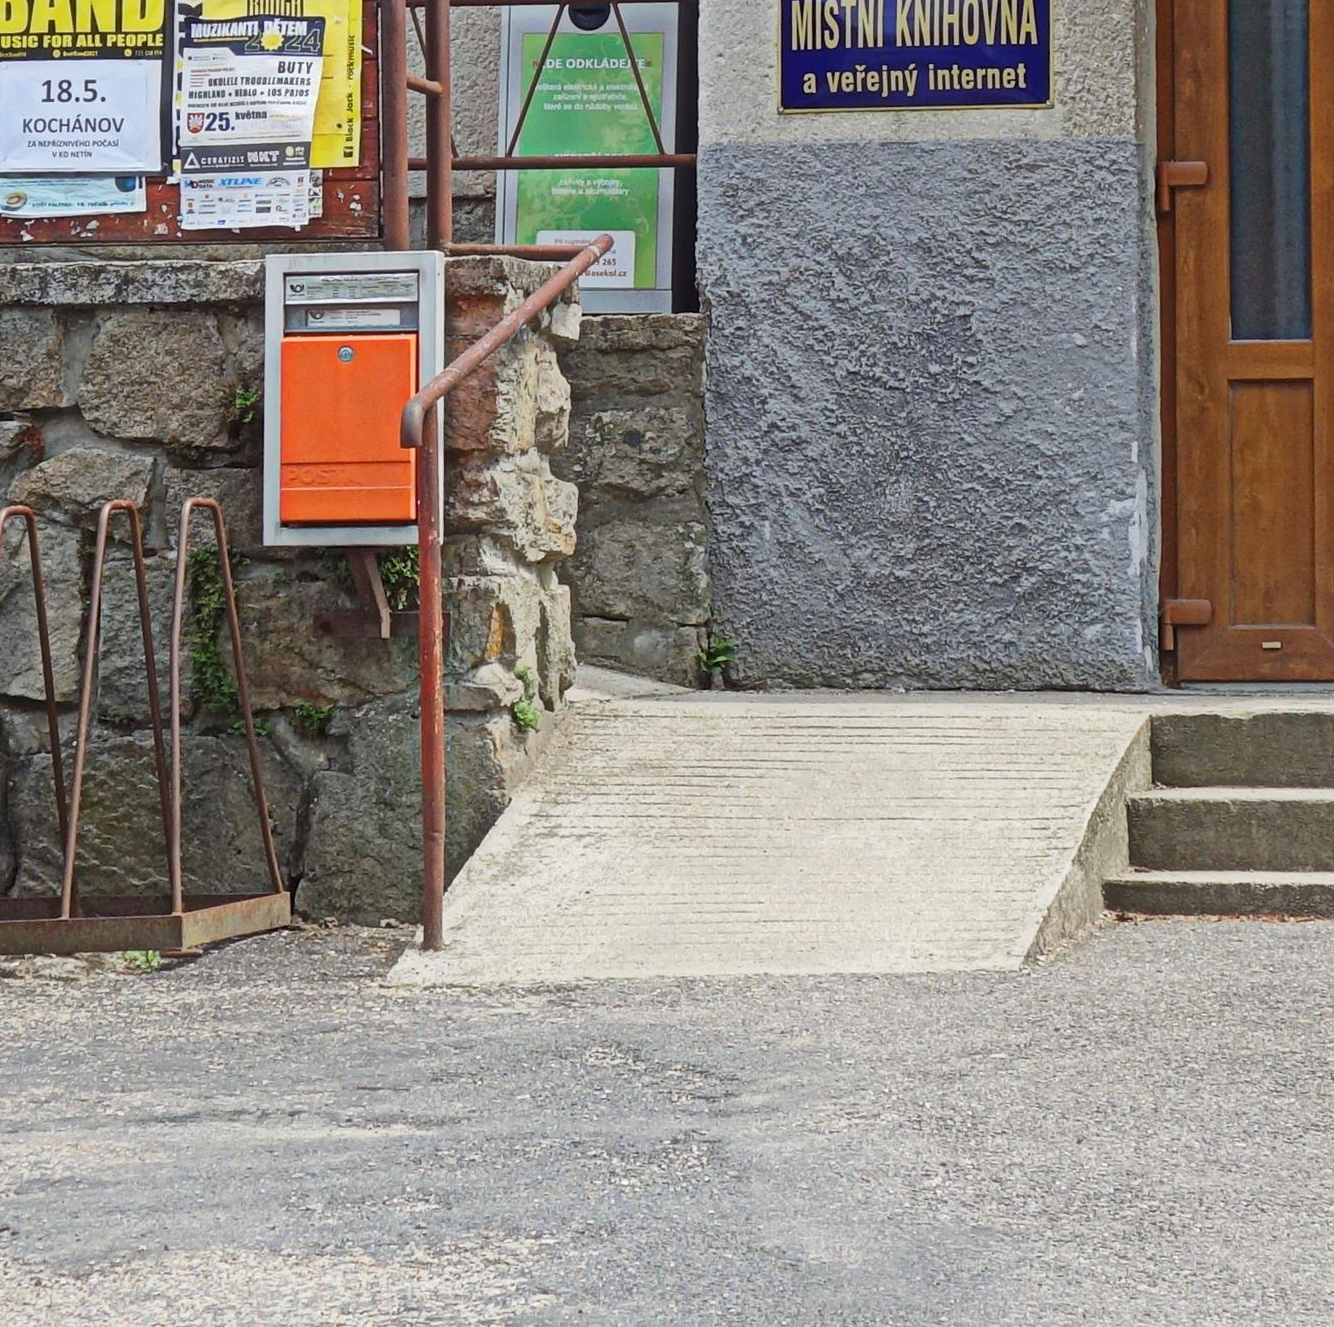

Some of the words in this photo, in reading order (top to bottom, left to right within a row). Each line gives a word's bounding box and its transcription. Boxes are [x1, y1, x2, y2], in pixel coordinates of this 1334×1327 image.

[191, 20, 259, 38] MUZIKANTI
[262, 18, 308, 37] DĚTEM
[43, 34, 74, 48] FOR
[76, 34, 105, 48] ALL
[107, 33, 164, 48] PEOPLE
[347, 34, 356, 81] rockmusic
[566, 57, 647, 70] ODKLÁDEJE
[278, 61, 314, 74] BUTY
[208, 76, 238, 87] UKULELE
[240, 76, 312, 86] TROUBLEMAKERS
[802, 71, 817, 94] a
[826, 61, 919, 99] veřejný
[928, 63, 1028, 91] internet
[40, 79, 107, 103] 18.5.
[188, 89, 226, 100] HIGHLAND
[346, 91, 354, 113] Jack
[22, 114, 125, 134] KOCHÁNOV
[204, 112, 235, 132] 25.
[235, 110, 268, 121] května
[345, 116, 354, 142] Black
[27, 140, 37, 148] ZA
[38, 139, 90, 148] NEPŘÍZNIVÉHO
[92, 138, 119, 148] POČASÍ
[58, 151, 69, 159] KD
[70, 150, 93, 158] NETÍN
[201, 155, 245, 165] CERATIZIT
[218, 177, 263, 187] XTLINE
